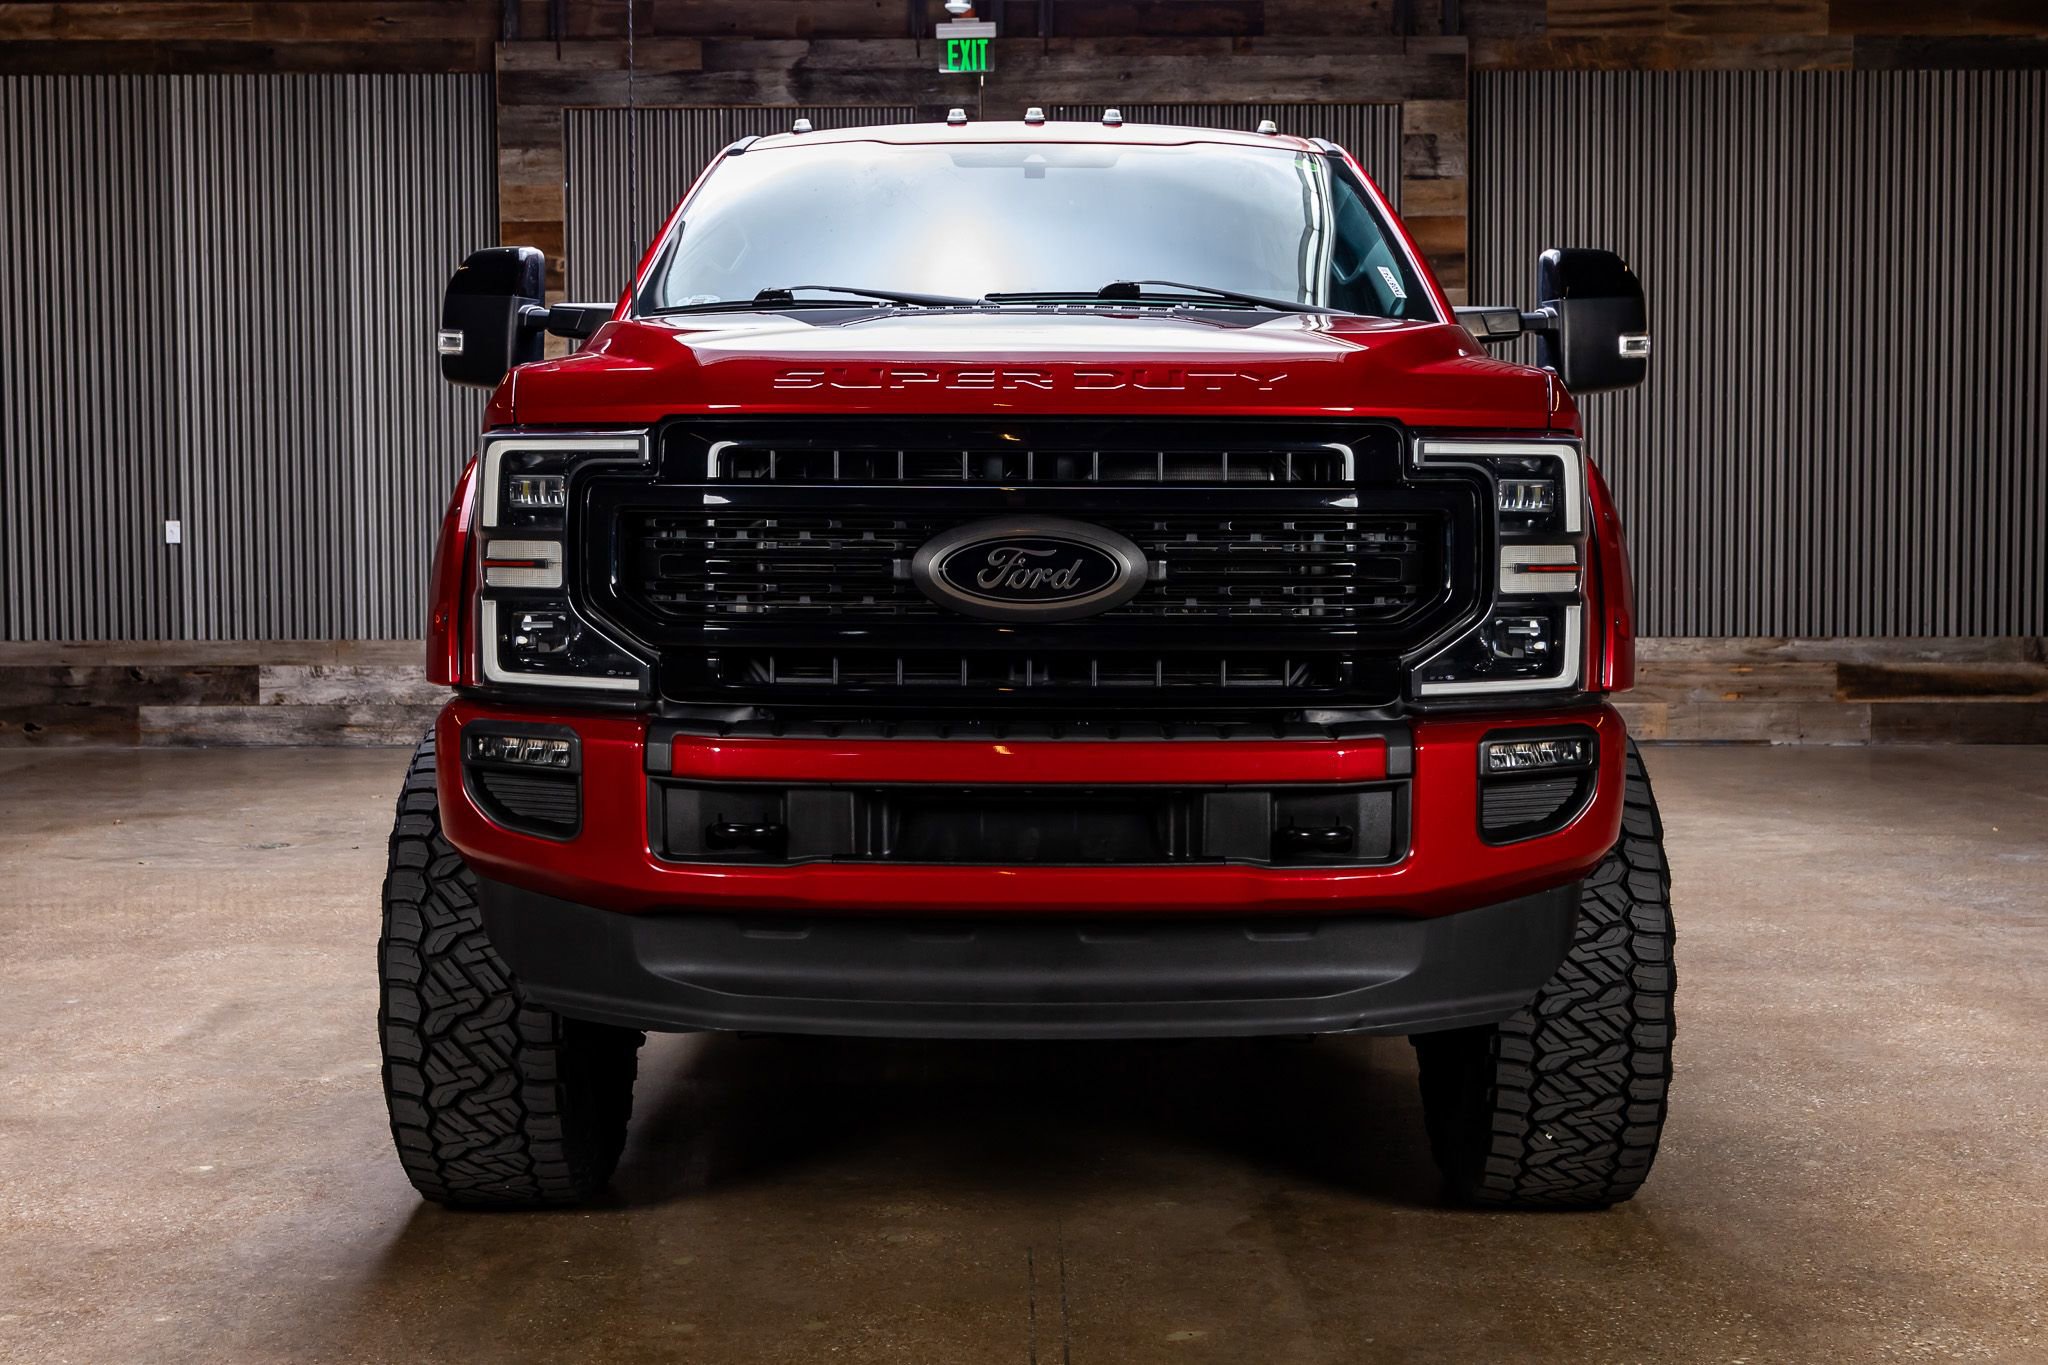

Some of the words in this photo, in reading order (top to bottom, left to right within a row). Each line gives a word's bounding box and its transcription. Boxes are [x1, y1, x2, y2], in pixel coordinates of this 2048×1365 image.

[947, 39, 988, 71] EXIT
[773, 368, 1054, 390] SUPER
[1073, 369, 1288, 391] DUTY
[976, 547, 1083, 590] Ford
